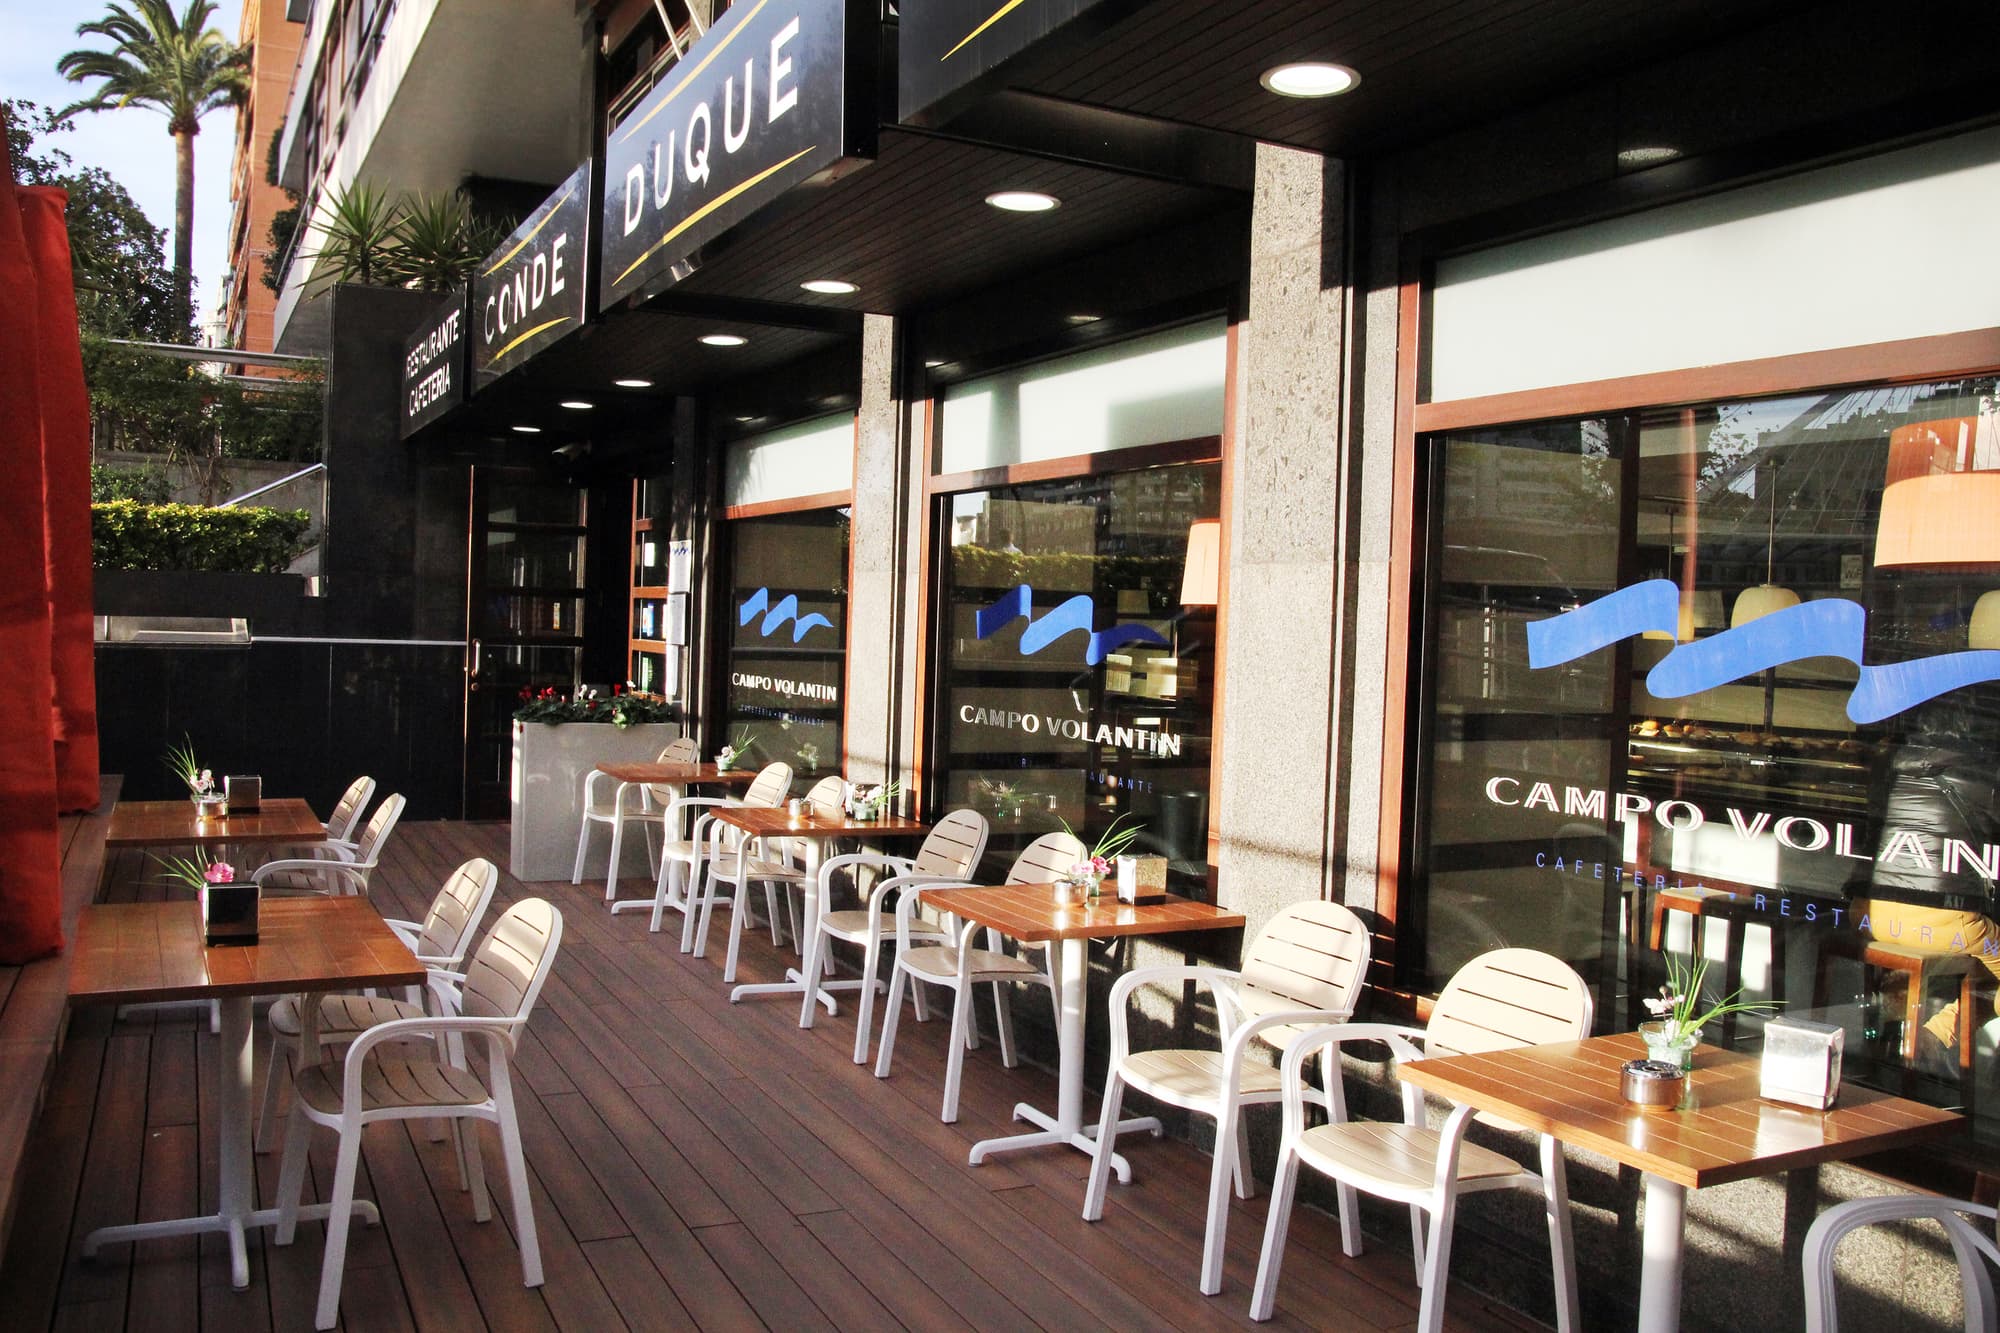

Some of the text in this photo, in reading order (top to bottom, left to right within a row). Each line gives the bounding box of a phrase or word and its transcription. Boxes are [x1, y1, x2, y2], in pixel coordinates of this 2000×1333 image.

[623, 16, 800, 237] DUQUE
[484, 233, 567, 345] CONDE
[405, 308, 460, 381] RESTAURANTE
[409, 362, 451, 417] CAFETERIA
[732, 672, 837, 701] CAMPO VOLANTIN
[960, 704, 1181, 756] CAMPO VOLANTIN
[1485, 776, 2000, 880] CAMPO VOLAN
[1535, 852, 1999, 957] CAFETERIA RESTAURAN
